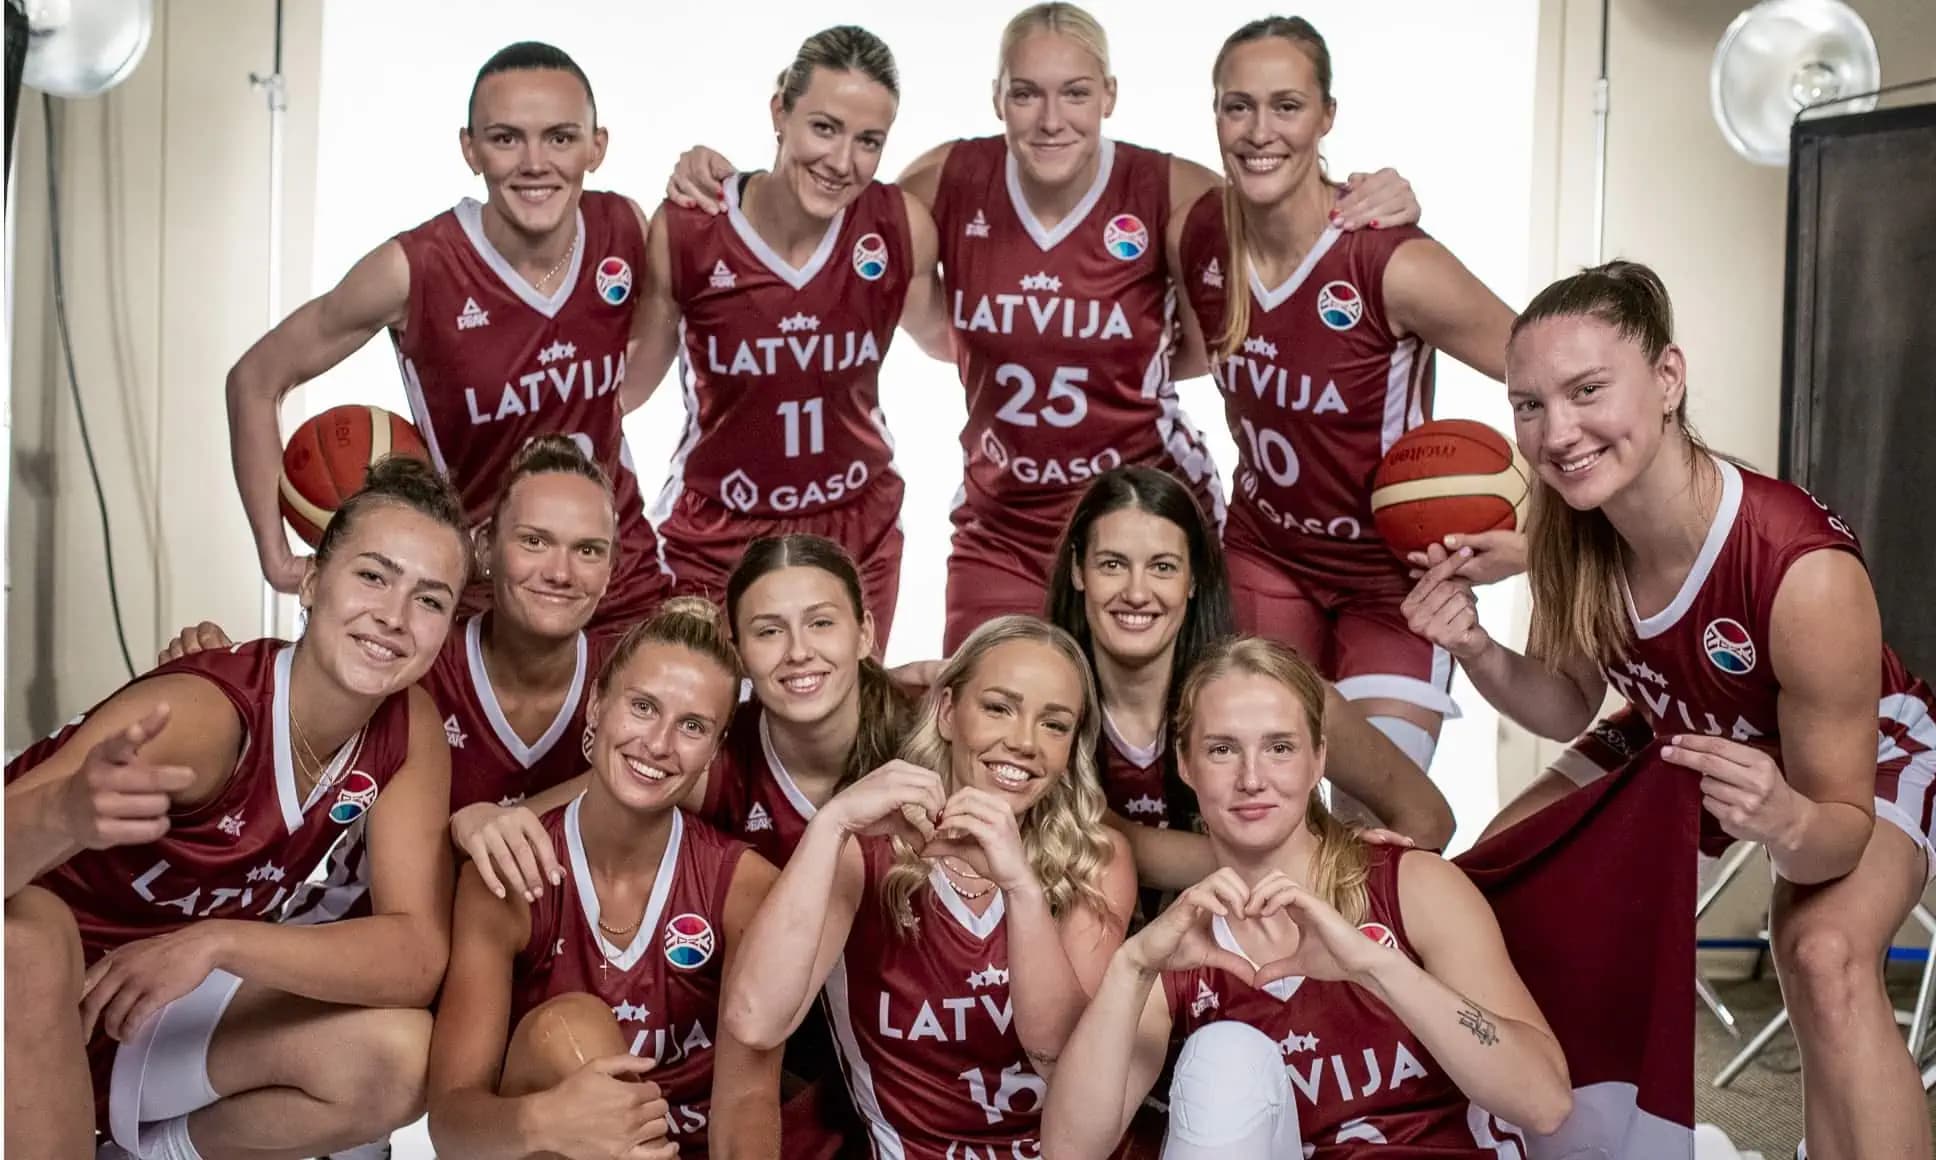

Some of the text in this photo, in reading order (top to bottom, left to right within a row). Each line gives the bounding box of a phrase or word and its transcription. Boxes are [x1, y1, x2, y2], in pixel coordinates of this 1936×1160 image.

[954, 289, 1133, 340] LATVIJA
[708, 330, 880, 376] LATVIJA
[995, 362, 1089, 428] 25
[776, 397, 825, 458] 11
[1241, 416, 1300, 488] 10
[769, 460, 869, 511] GASO
[1011, 448, 1121, 485] GASO
[1607, 666, 1765, 742] TVIJA
[879, 991, 1014, 1042] LATV
[1286, 1041, 1428, 1106] VIJA
